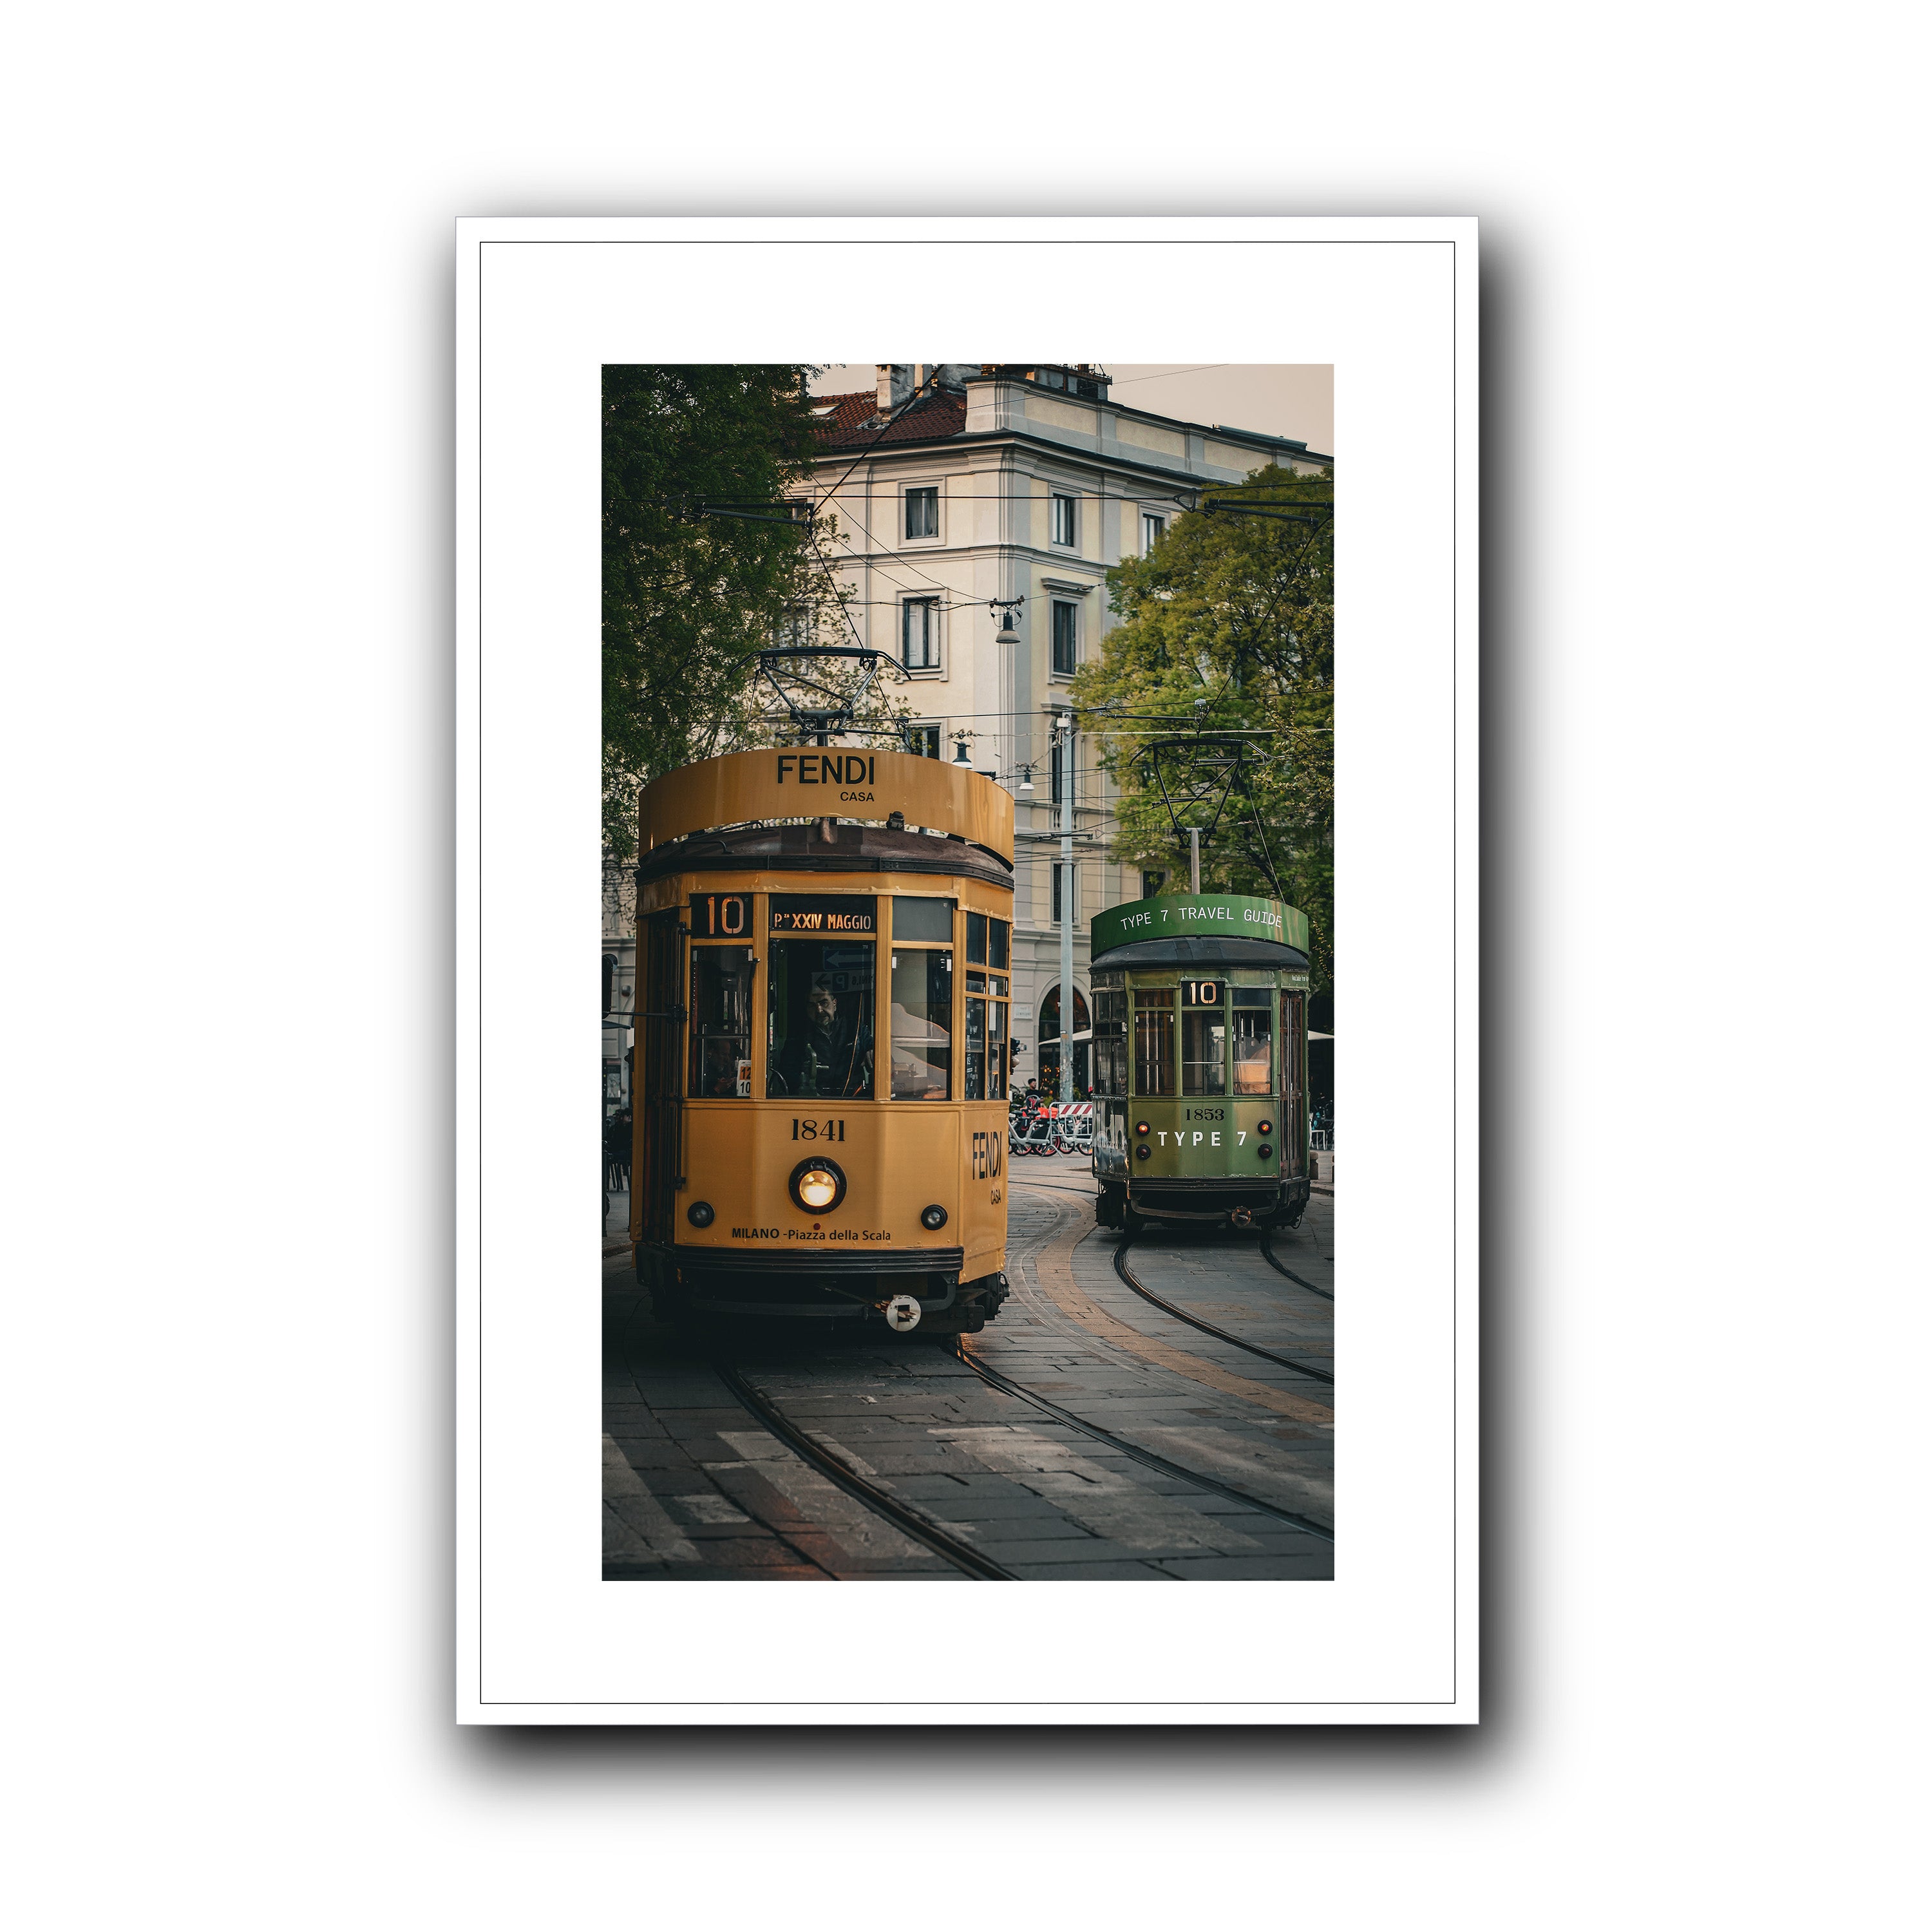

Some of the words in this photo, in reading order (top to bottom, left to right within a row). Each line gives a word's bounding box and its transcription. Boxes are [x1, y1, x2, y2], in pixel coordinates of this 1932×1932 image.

[777, 755, 875, 785] FENDI
[840, 791, 875, 802] CASA
[707, 896, 744, 934] 10
[791, 913, 822, 929] XXIV
[827, 914, 871, 929] MAGGIO
[1121, 912, 1151, 930] TYPE
[1160, 909, 1168, 922] 7
[1178, 907, 1234, 920] TRAVEL
[1244, 909, 1282, 928] GUIDE
[1190, 982, 1217, 1004] 10
[741, 1067, 751, 1079] 12
[740, 1081, 751, 1094] 10
[1186, 1108, 1224, 1121] 1853
[791, 1119, 845, 1142] 1841
[1157, 1132, 1221, 1146] TYPE
[1237, 1132, 1247, 1146] 7
[972, 1131, 1002, 1180] FENDI
[990, 1189, 1001, 1205] CASA
[732, 1228, 779, 1239] MILANO
[829, 1229, 858, 1240] della
[862, 1230, 891, 1241] Scala
